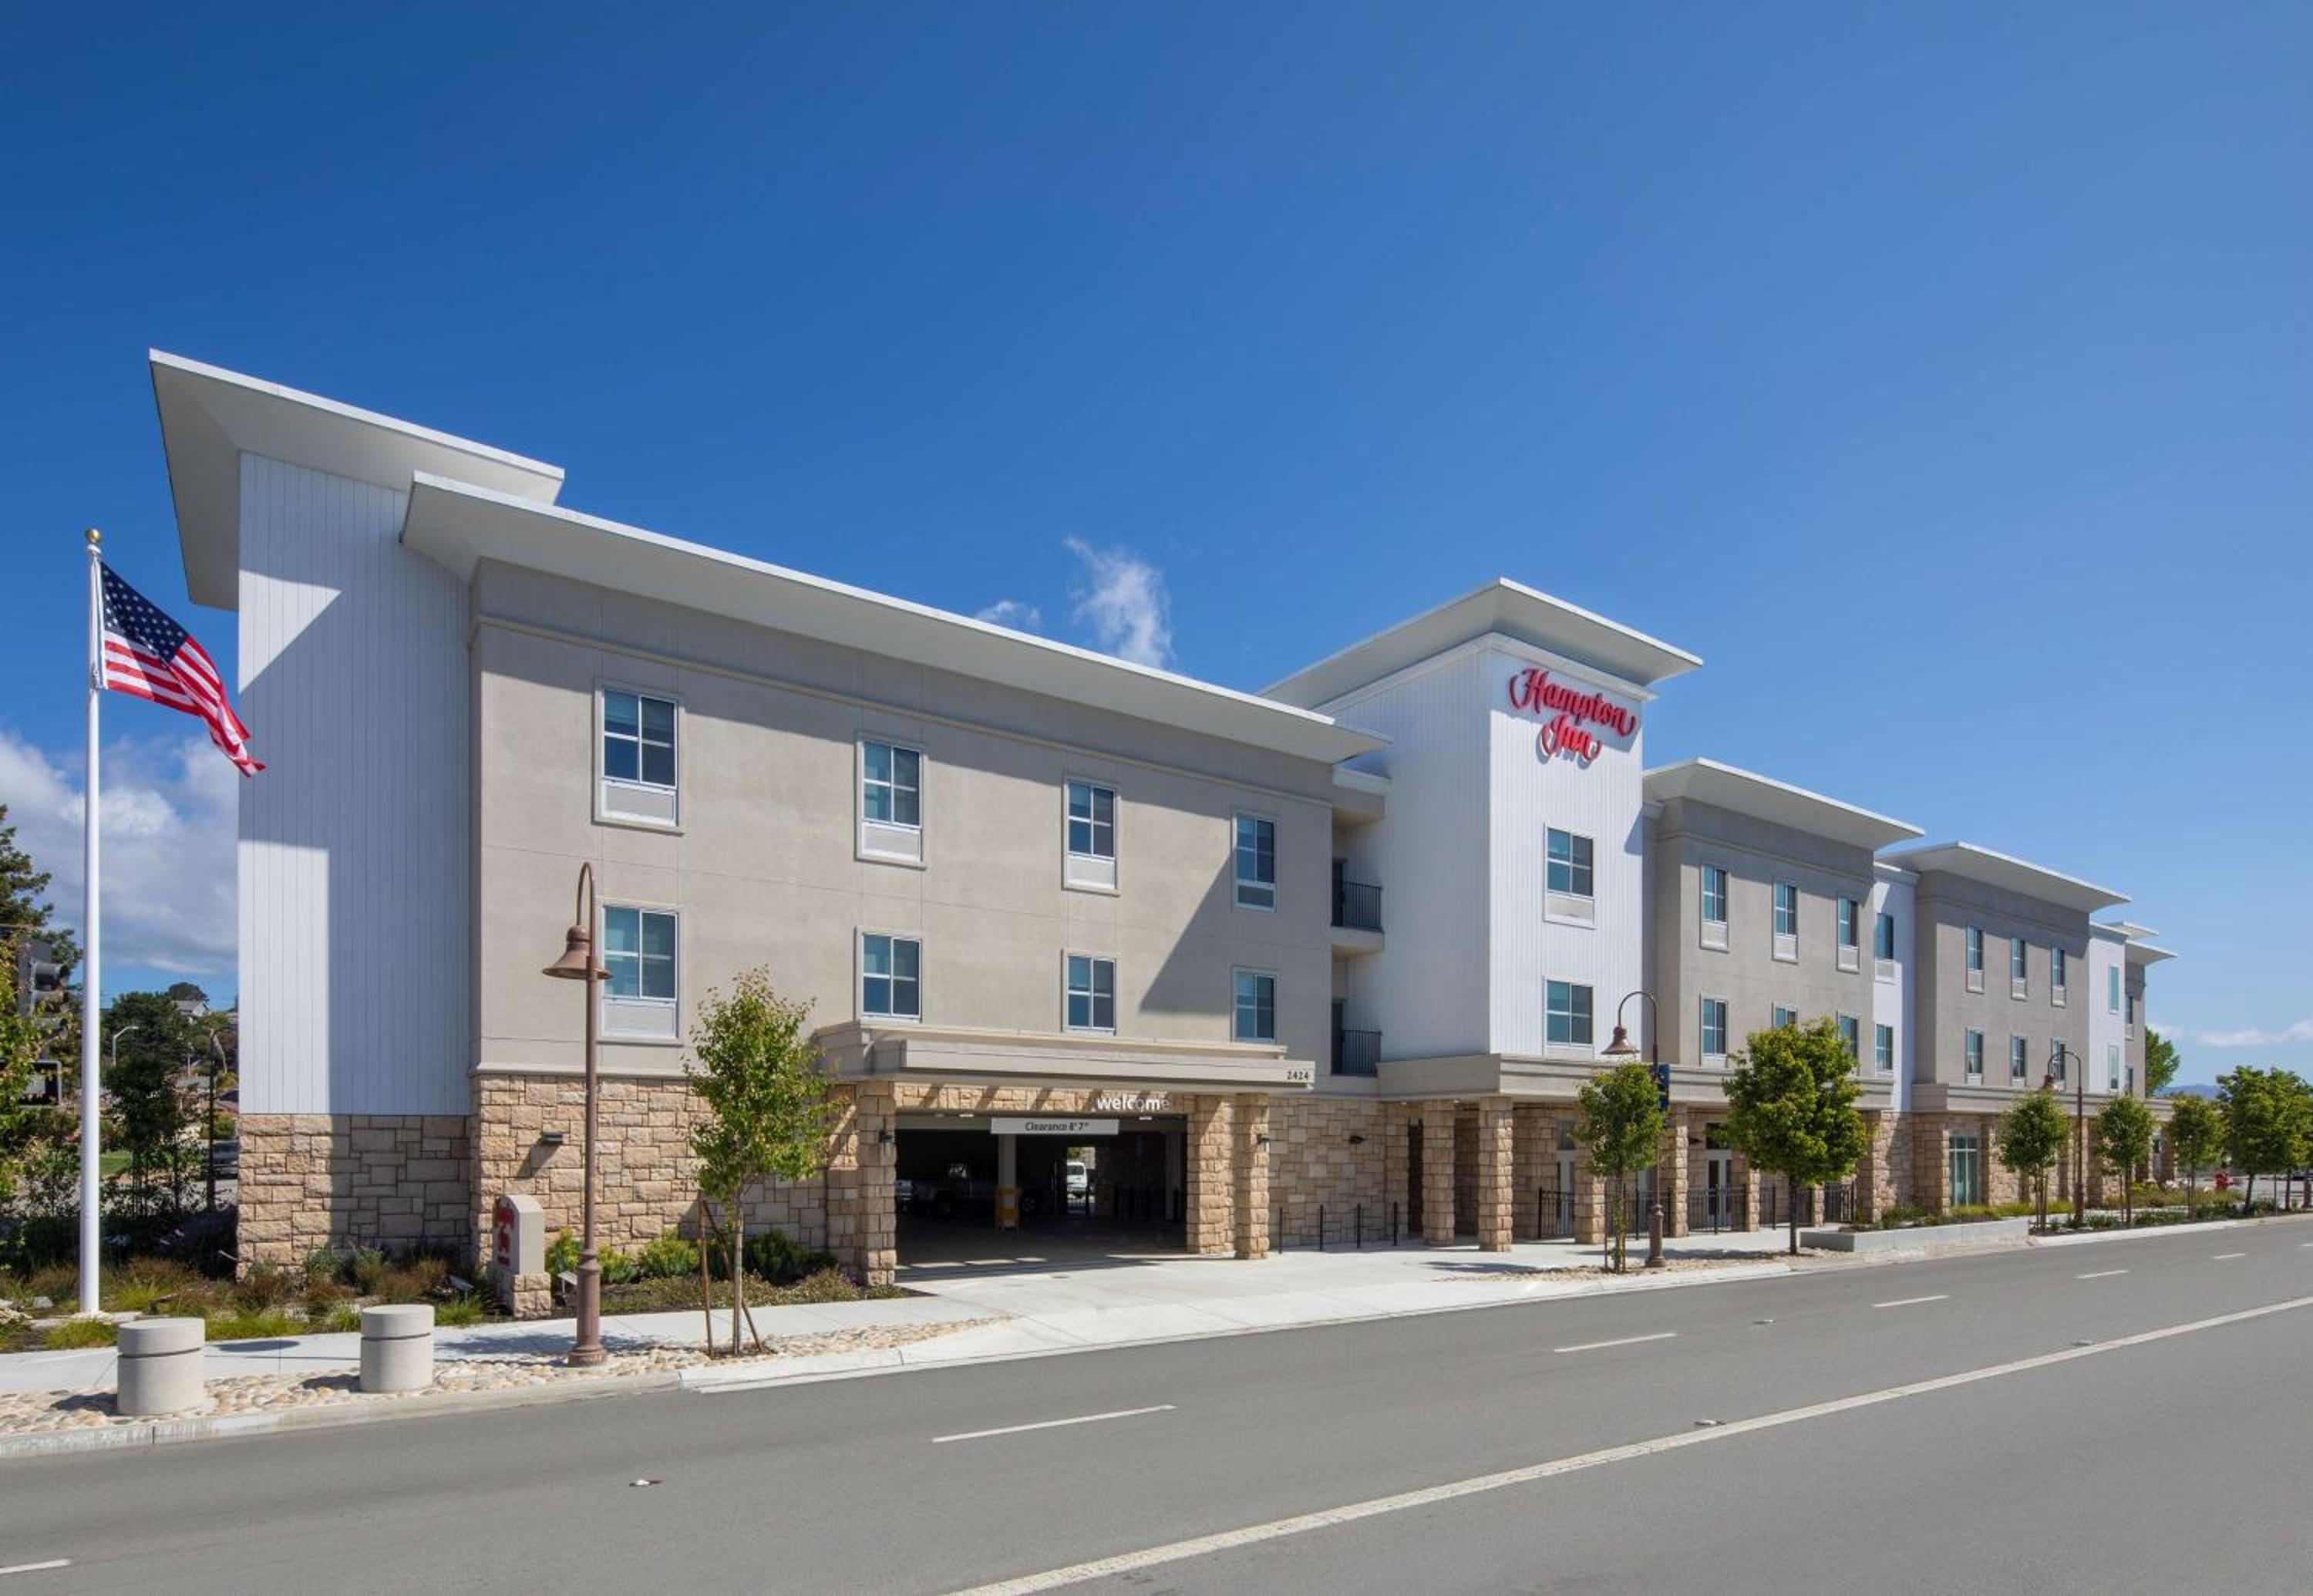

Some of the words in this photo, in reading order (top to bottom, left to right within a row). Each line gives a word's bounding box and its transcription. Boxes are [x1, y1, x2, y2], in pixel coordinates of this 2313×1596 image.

[1509, 667, 1637, 736] Hampton
[1541, 715, 1603, 761] Inn
[1287, 1071, 1308, 1080] 2424
[1097, 1094, 1170, 1111] welcome
[1025, 1122, 1067, 1131] Clearance
